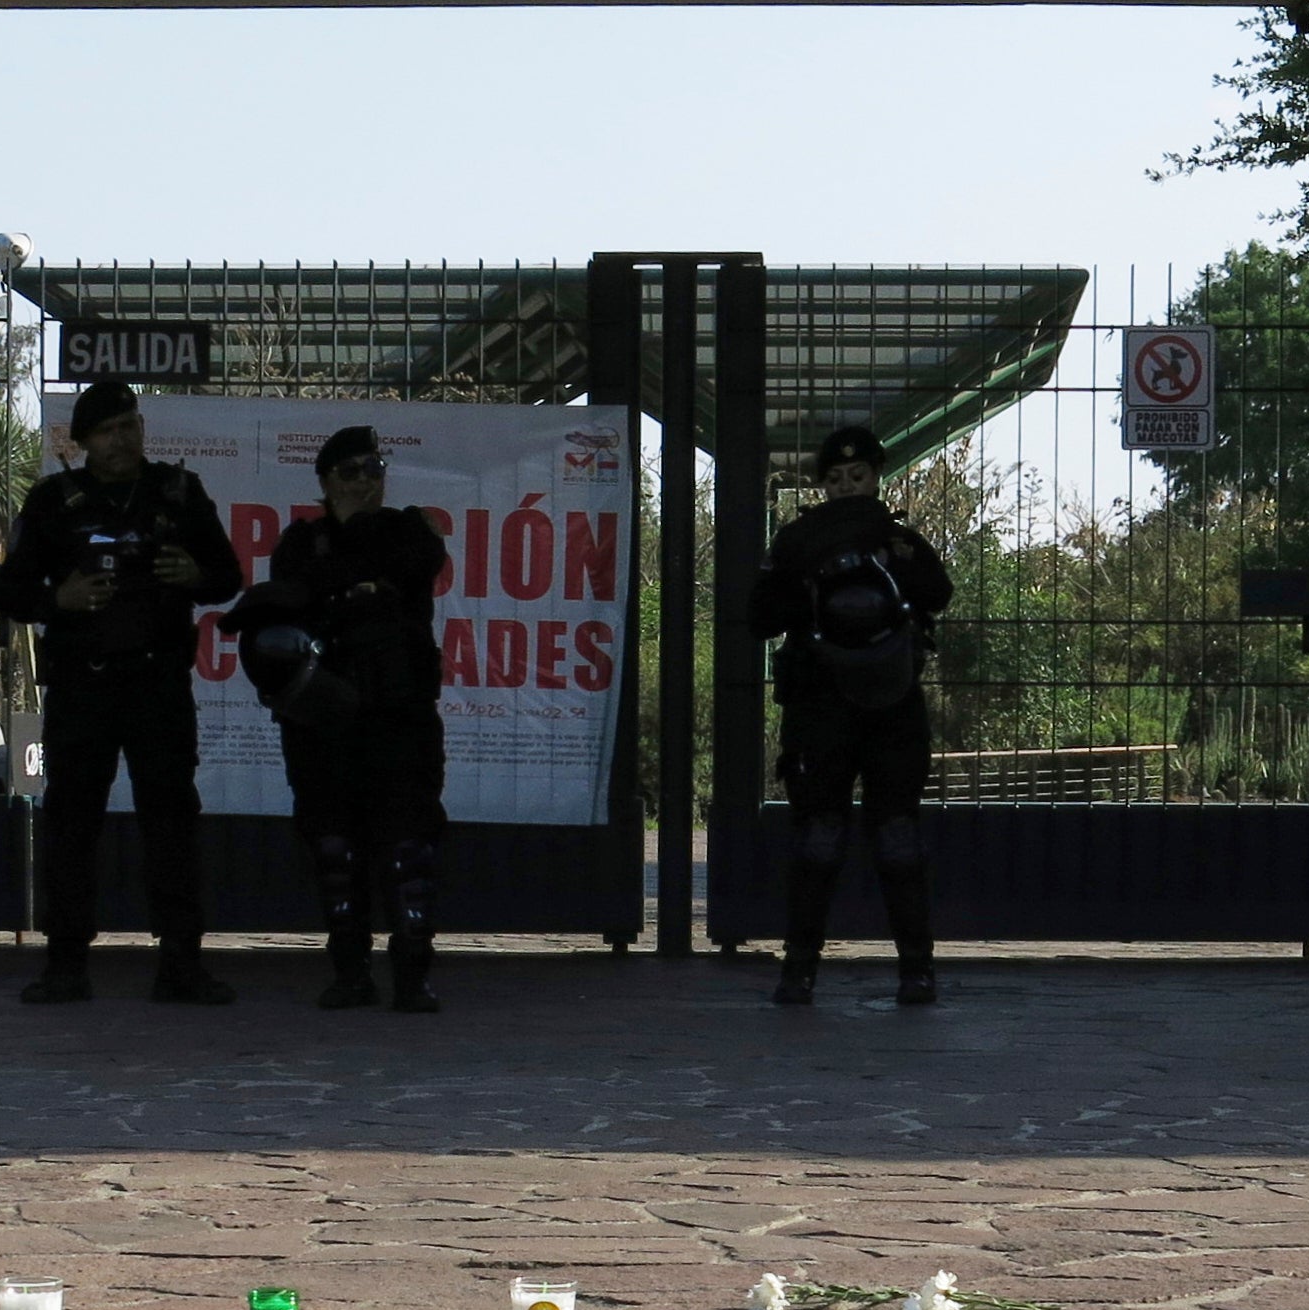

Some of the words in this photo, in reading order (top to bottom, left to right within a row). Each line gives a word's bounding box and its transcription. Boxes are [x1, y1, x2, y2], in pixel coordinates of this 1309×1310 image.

[68, 332, 199, 374] SALIDA
[1136, 412, 1199, 423] PROHIBIDO
[1135, 422, 1172, 432] PASAR
[1176, 422, 1200, 432] CON
[1136, 432, 1199, 443] MASCOTAS
[143, 446, 181, 456] CIUDAD
[184, 447, 197, 457] DE
